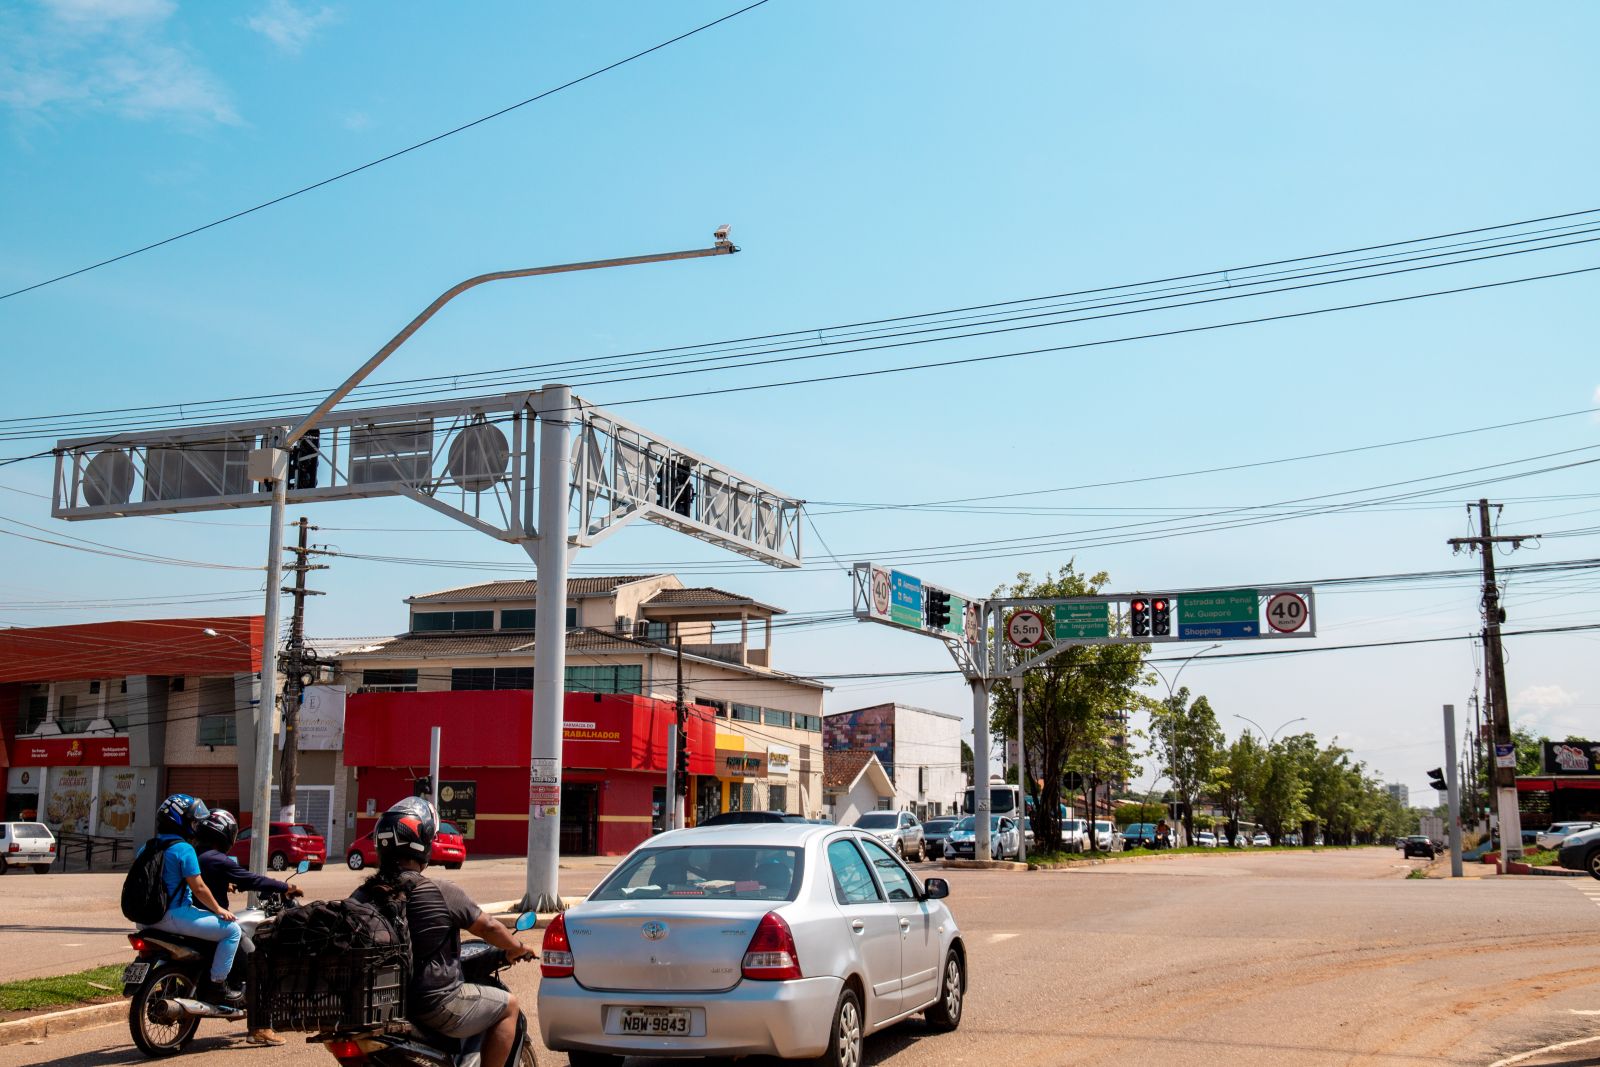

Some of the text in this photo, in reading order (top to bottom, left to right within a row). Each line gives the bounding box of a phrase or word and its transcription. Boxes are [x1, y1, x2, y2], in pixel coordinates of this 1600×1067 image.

[875, 581, 887, 599] 40
[1197, 609, 1231, 618] Guaporé
[1271, 601, 1300, 619] 40
[1013, 625, 1039, 635] 5,5m
[1184, 628, 1222, 636] Shopping
